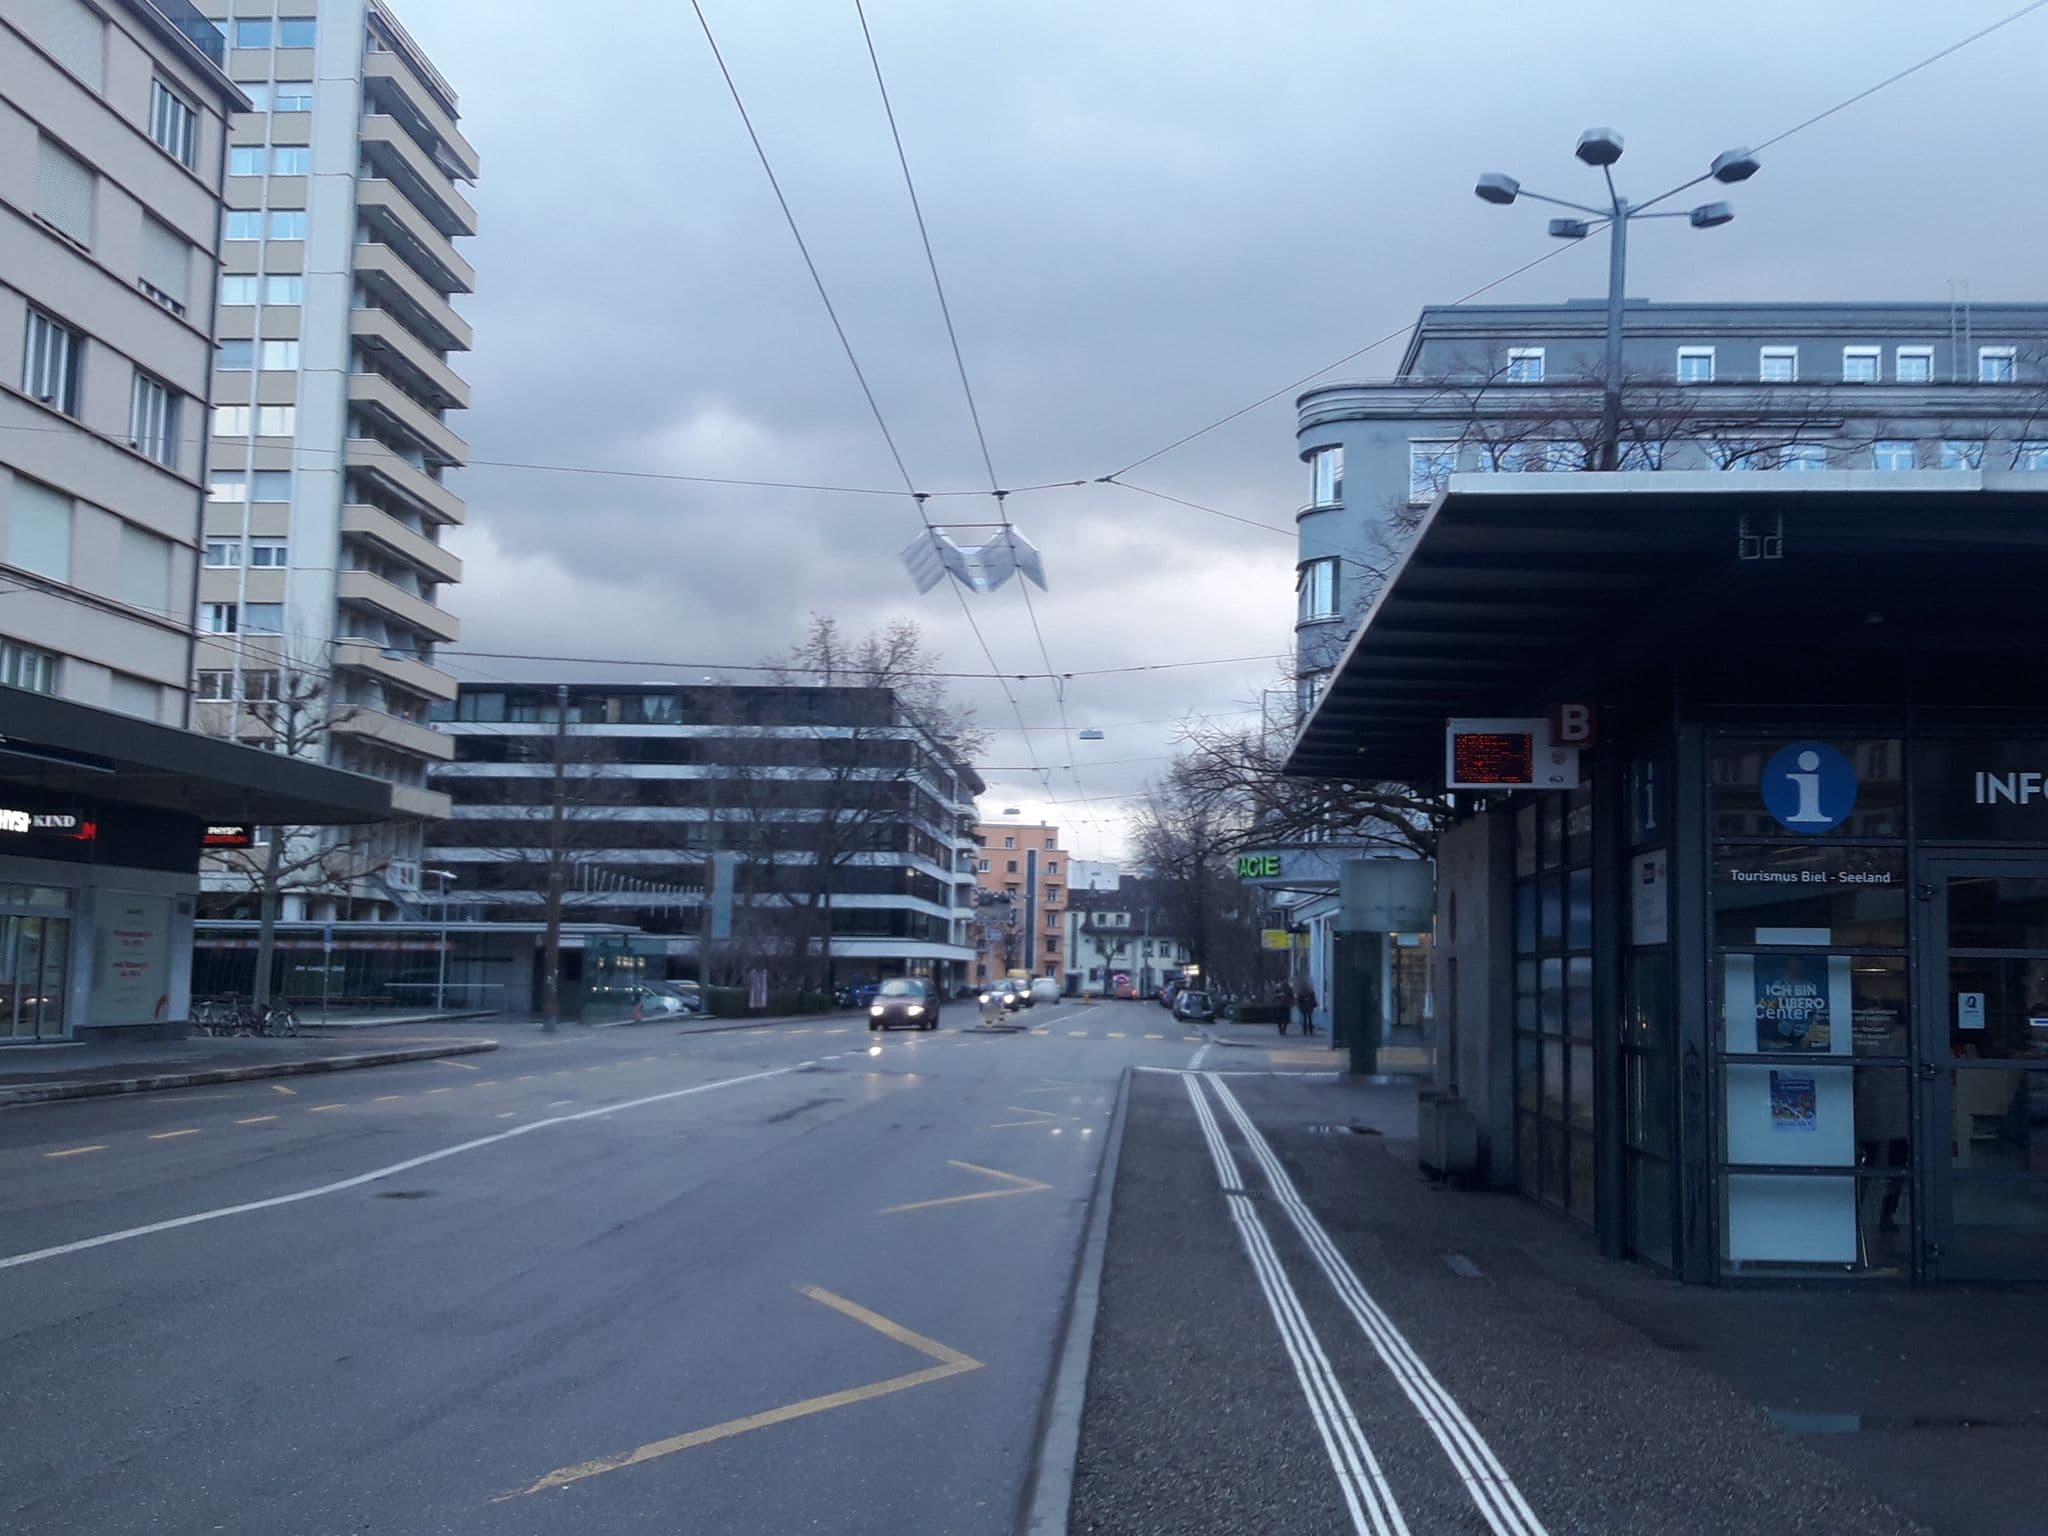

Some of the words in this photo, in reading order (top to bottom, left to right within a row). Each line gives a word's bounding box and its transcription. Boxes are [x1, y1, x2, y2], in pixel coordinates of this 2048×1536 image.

[1562, 703, 1590, 740] B
[1975, 771, 2048, 804] INF
[33, 815, 76, 828] KIND
[1730, 869, 1798, 882] Tourismus
[1801, 871, 1827, 883] Biel
[1839, 871, 1891, 883] Seeland
[1779, 997, 1825, 1009] LIBERO
[1755, 1004, 1812, 1020] Center
